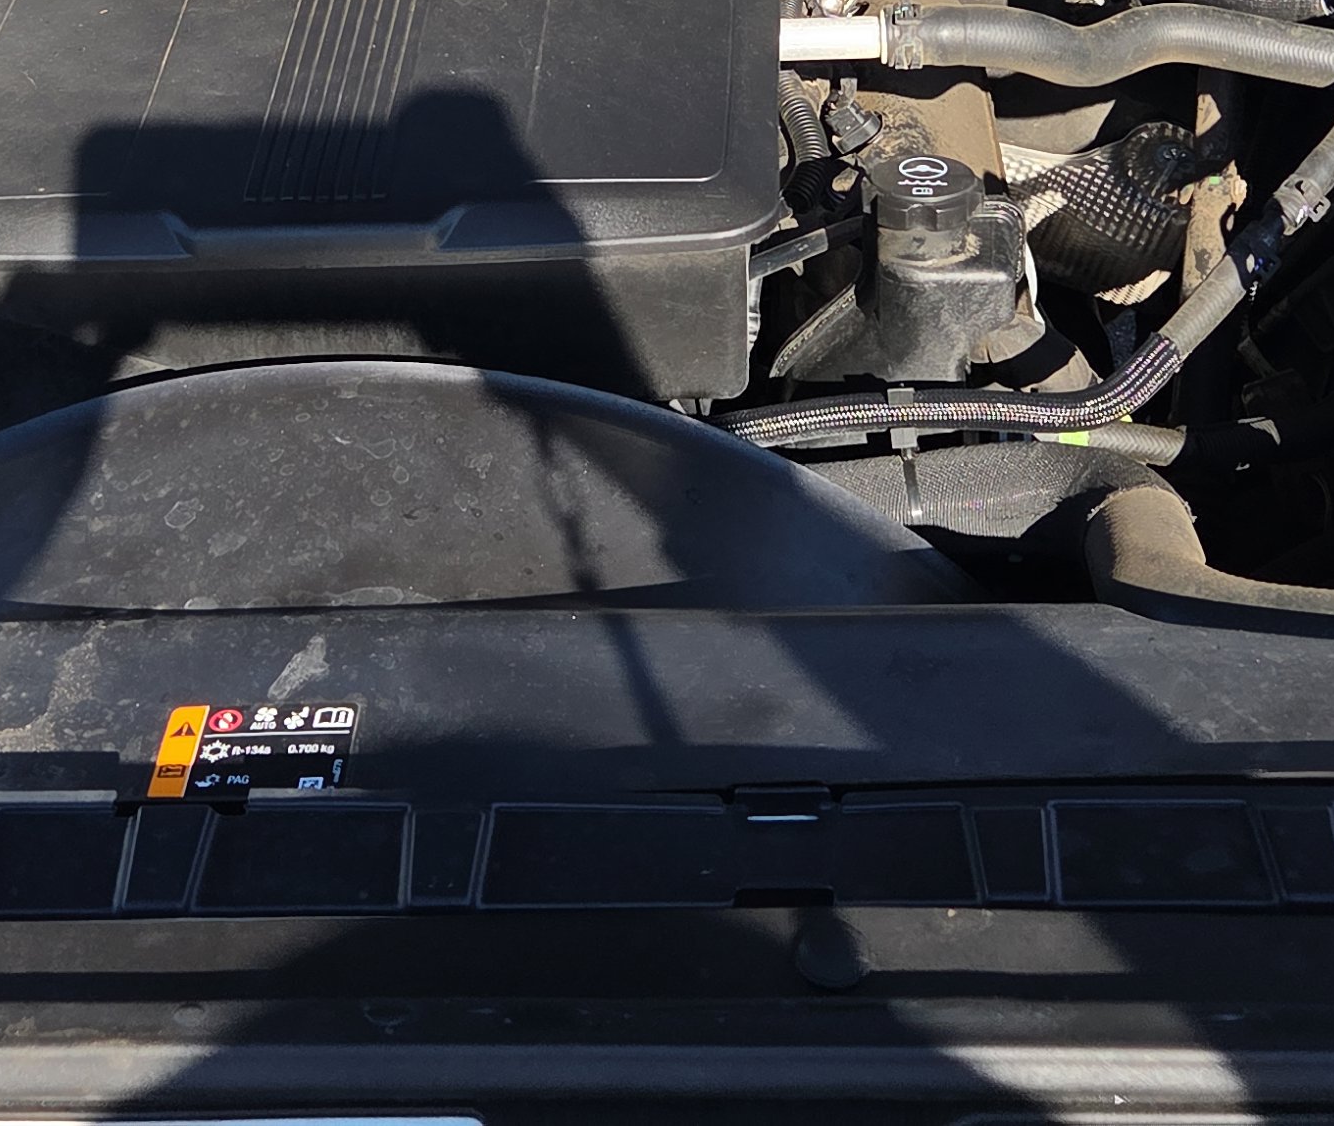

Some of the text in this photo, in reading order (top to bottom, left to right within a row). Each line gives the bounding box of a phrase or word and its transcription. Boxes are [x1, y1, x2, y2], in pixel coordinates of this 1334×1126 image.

[249, 721, 277, 731] AUTO
[287, 743, 319, 754] 0.700
[320, 743, 335, 755] kg
[227, 775, 250, 785] PAG
